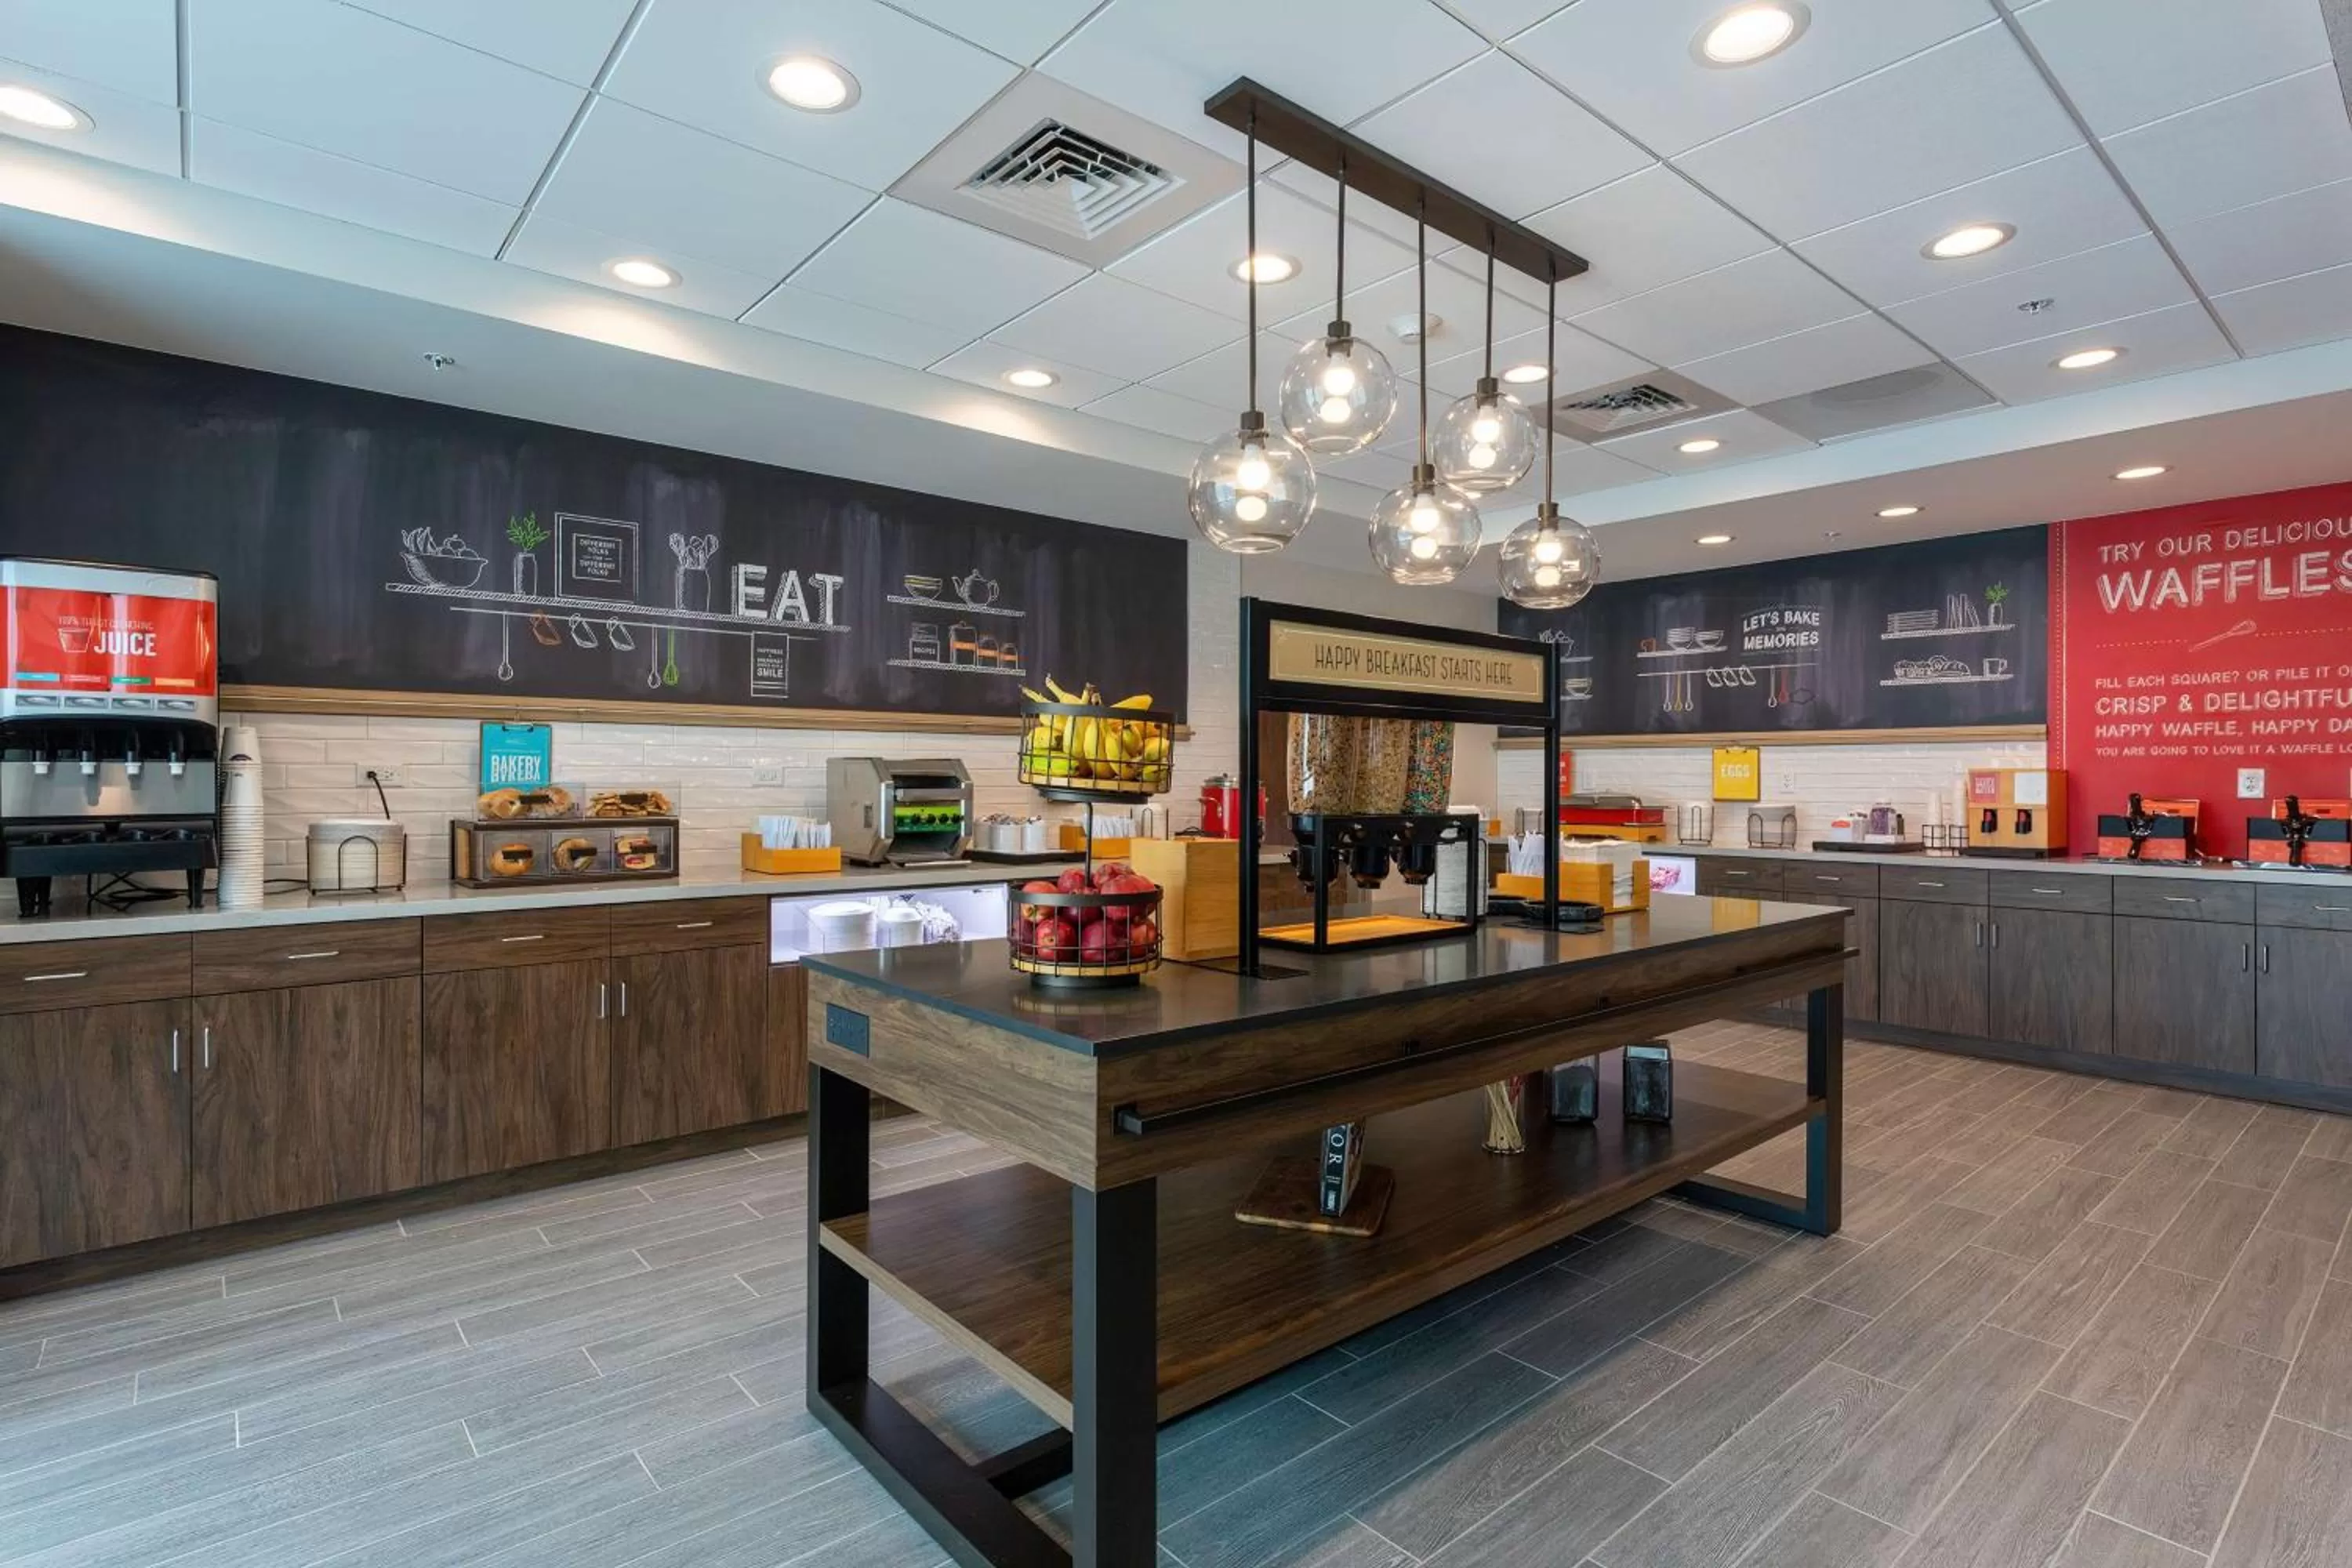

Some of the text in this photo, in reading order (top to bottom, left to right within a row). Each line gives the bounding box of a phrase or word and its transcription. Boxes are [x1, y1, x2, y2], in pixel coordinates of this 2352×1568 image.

[2098, 541, 2145, 564] TRY
[2157, 533, 2212, 557] OUR
[731, 563, 844, 625] EAT
[1743, 611, 1820, 633] LET'S BAKE
[94, 631, 157, 656] JUICE
[1744, 630, 1819, 650] MEMORIES
[757, 668, 783, 677] SMILE
[1315, 644, 1512, 685] HAPPY BREAKFAST STARTS HERE
[2096, 665, 2352, 688] FILL EACH SQUARE? OR PILE IT O
[2095, 695, 2167, 715] CRISP
[2178, 694, 2193, 713] &
[2095, 724, 2153, 738] HAPPY
[2161, 720, 2243, 737] WAFFLE,
[2252, 718, 2319, 735] HAPPY
[2096, 747, 2118, 757] YOU
[2123, 746, 2145, 757] ARE
[2151, 746, 2187, 756] GOING
[2194, 746, 2208, 755] TO
[2213, 745, 2244, 755] LOVE
[2250, 744, 2263, 753] IT
[2265, 745, 2275, 753] A
[2281, 743, 2333, 753] WAFFLE
[491, 754, 541, 782] BAKERY
